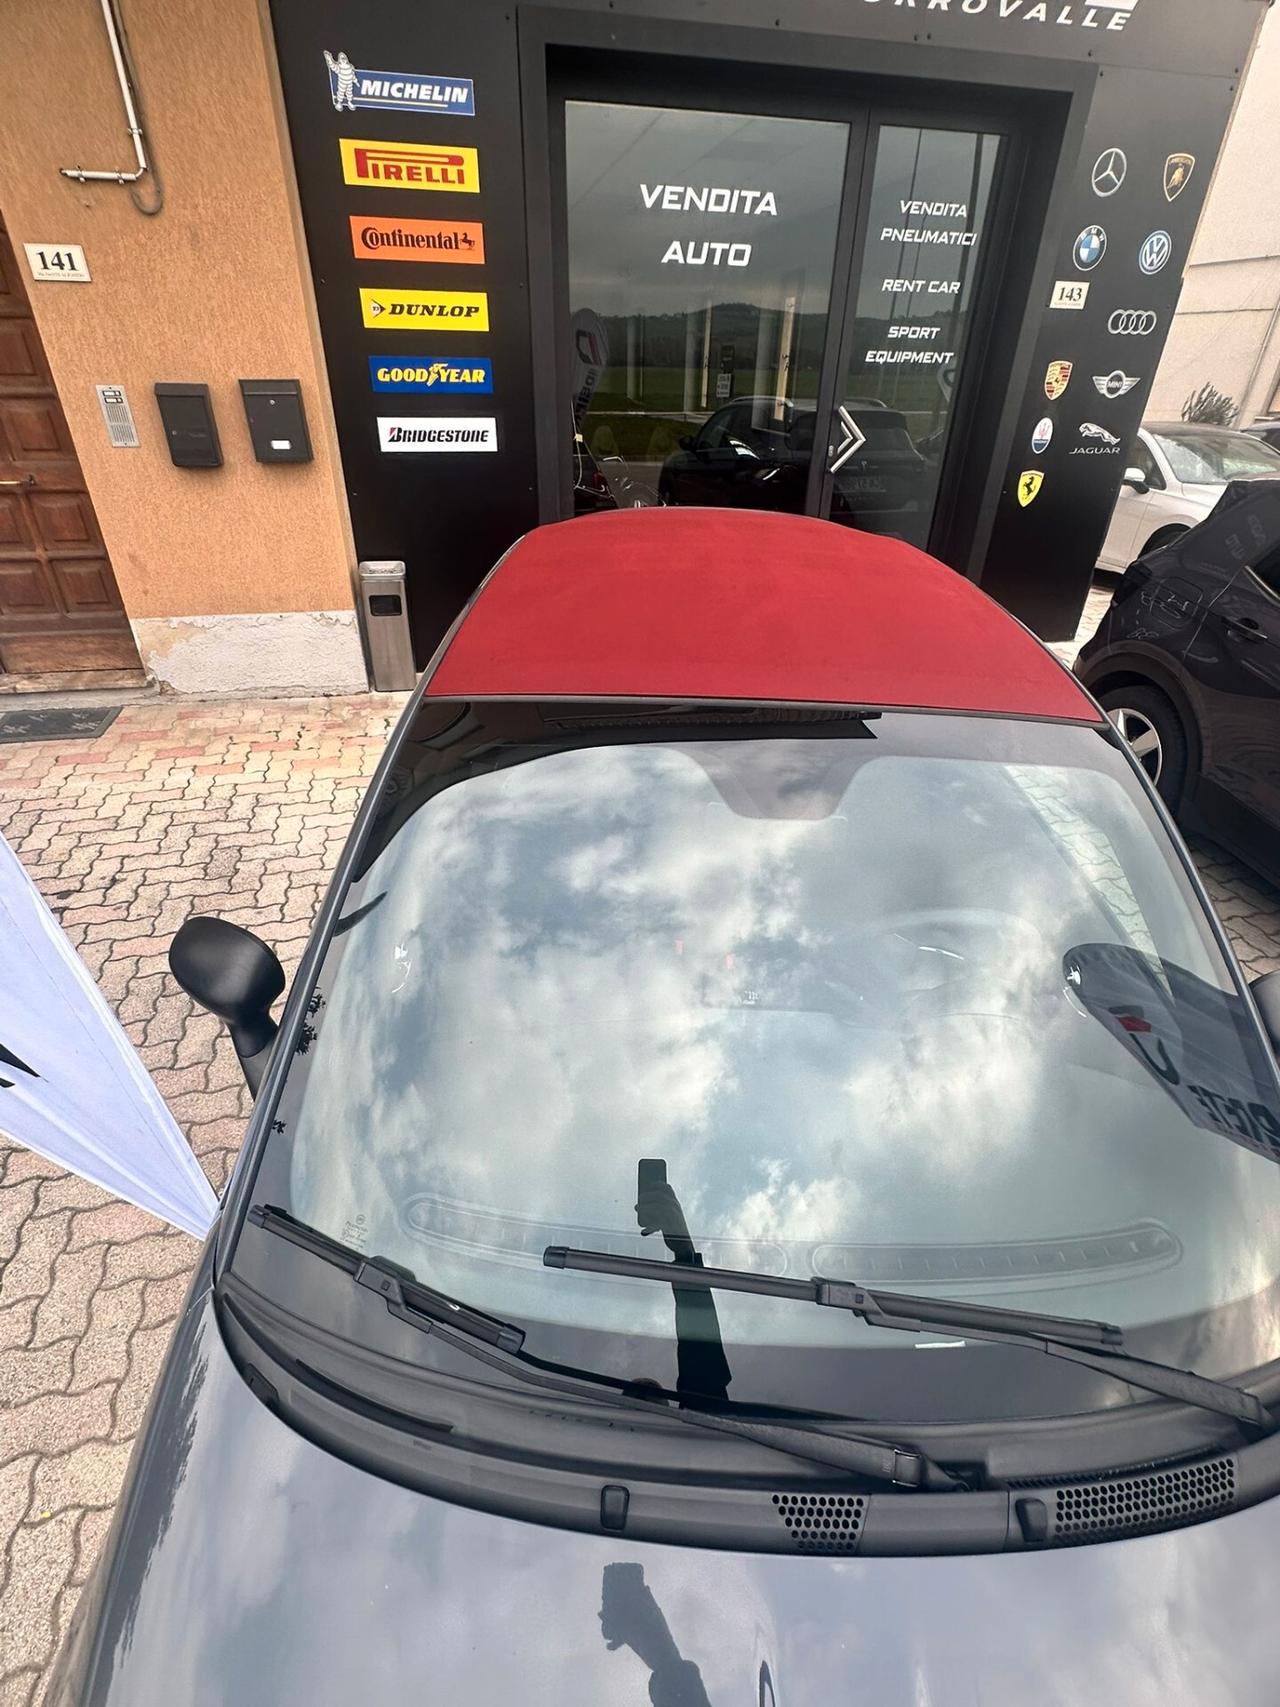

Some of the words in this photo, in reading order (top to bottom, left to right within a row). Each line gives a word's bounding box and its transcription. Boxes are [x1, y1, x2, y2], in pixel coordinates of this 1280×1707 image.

[360, 80, 468, 103] MICHELIN
[354, 148, 465, 185] PIRELLI
[639, 184, 778, 216] VENDITA
[899, 200, 968, 218] VENDITA
[361, 227, 460, 250] Continental
[880, 227, 977, 247] PNEUMATICI
[36, 251, 79, 271] 141
[660, 240, 752, 267] AUTO
[881, 279, 926, 293] RENT
[927, 280, 961, 294] CAR
[1058, 286, 1083, 302] 143
[388, 303, 480, 318] DUNLOP
[887, 325, 941, 340] SPORT
[865, 349, 954, 365] EQUIPMENT
[387, 426, 489, 443] BRIDGESTONE
[1068, 447, 1121, 455] JAGUAR
